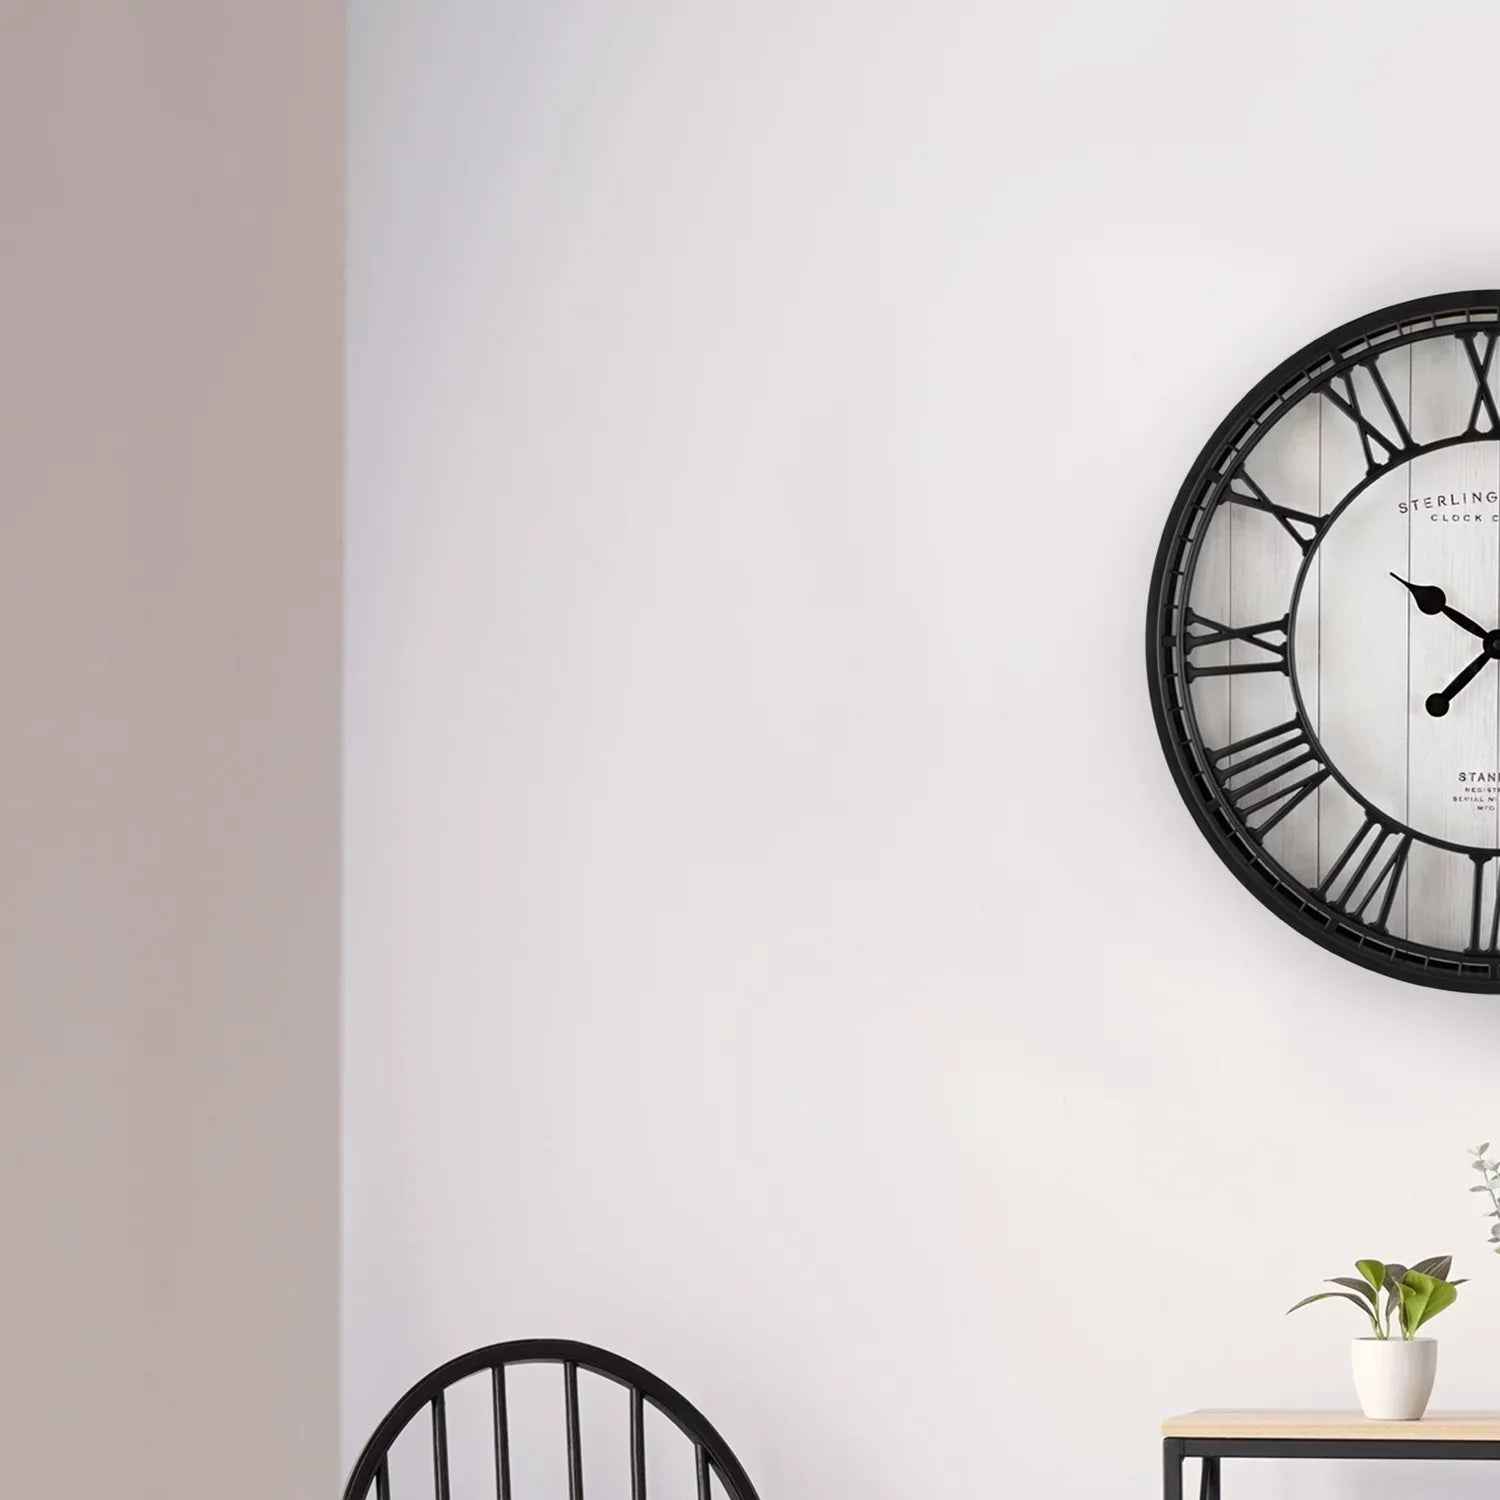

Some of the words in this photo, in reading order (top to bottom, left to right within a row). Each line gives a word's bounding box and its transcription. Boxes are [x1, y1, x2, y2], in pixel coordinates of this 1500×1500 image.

[1313, 353, 1421, 478] XI
[1221, 465, 1330, 557] X
[1398, 491, 1498, 514] STERLING
[1430, 513, 1483, 523] CLOCK
[1185, 607, 1291, 684] IX
[1204, 711, 1333, 846] VIII
[1310, 807, 1414, 935] VII
